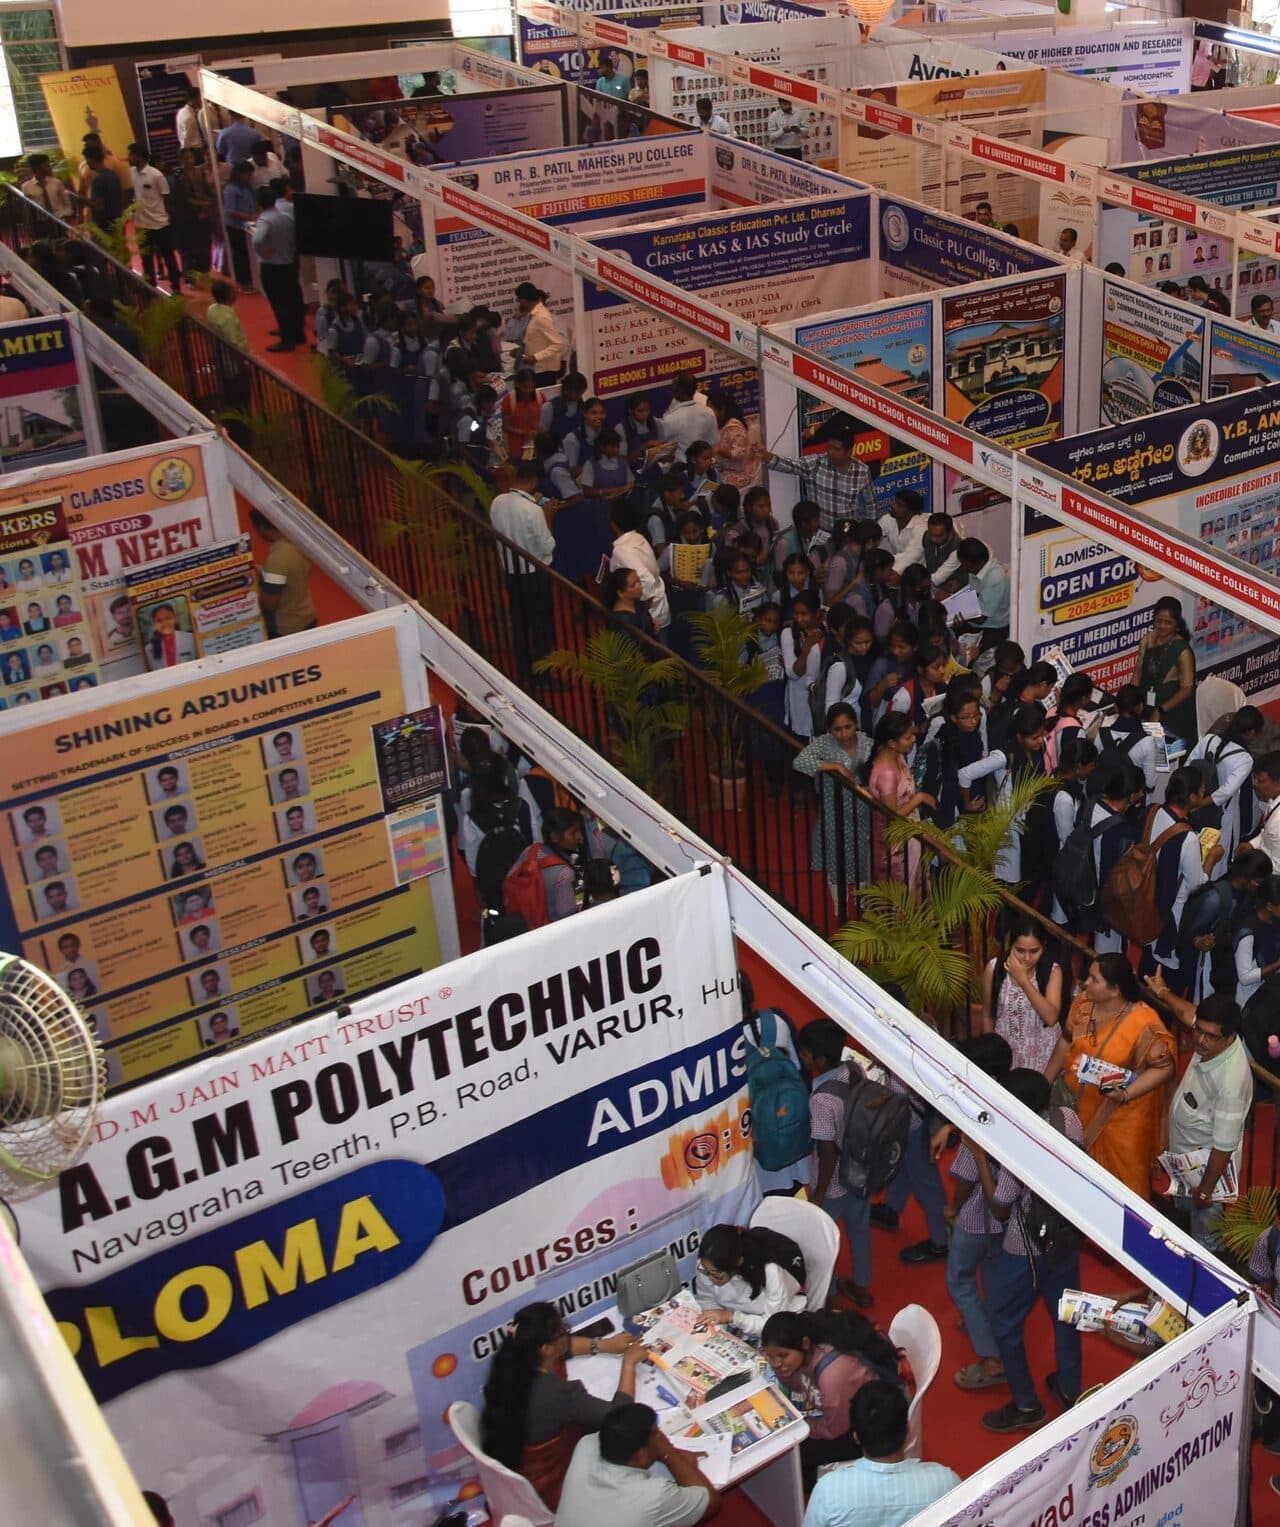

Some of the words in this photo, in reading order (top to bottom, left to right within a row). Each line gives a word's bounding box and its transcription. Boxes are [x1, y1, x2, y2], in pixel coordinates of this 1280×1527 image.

[1028, 51, 1039, 60] OF
[1041, 46, 1072, 58] HIGHER
[1075, 42, 1120, 54] EDUCATION
[1122, 41, 1140, 51] AND
[1142, 37, 1182, 50] RESEARCH
[1123, 72, 1174, 82] HOMOEOPATHIC
[544, 161, 574, 177] PATIL
[577, 154, 626, 172] MAHESH
[628, 152, 643, 166] PU
[646, 144, 694, 162] COLLEGE
[991, 147, 1023, 164] UNIVERSITY
[1023, 156, 1058, 176] DAVANGERE
[542, 200, 586, 216] FUTURE
[589, 193, 630, 208] BEGINS
[653, 230, 696, 246] Karnataka
[698, 224, 728, 239] Classic
[730, 217, 771, 234] Education
[810, 204, 846, 220] Dharwad
[646, 248, 694, 268] Classic
[698, 241, 728, 258] KAS
[774, 227, 810, 246] Study
[814, 219, 854, 238] Circle
[914, 226, 944, 250] Classic
[948, 238, 964, 256] PU
[773, 273, 816, 289] Examinations
[602, 262, 614, 276] THE
[614, 268, 634, 286] CLASSIC
[660, 293, 676, 310] STUDY
[678, 302, 698, 320] CIRCLE
[698, 312, 724, 334] DHARWAD
[734, 296, 754, 307] FDA
[604, 308, 634, 319] Special
[1172, 310, 1195, 327] SCIENCE
[671, 338, 688, 350] SSC
[618, 368, 646, 383] BOOKS
[826, 375, 850, 394] KALUTI
[850, 386, 876, 408] SPORTS
[877, 399, 906, 423] SCHOOL
[907, 412, 950, 446] CHANDARGI
[1222, 418, 1252, 442] Y.B.
[1248, 432, 1260, 446] PU
[882, 453, 928, 474] 2024-2025
[1223, 444, 1266, 465] Commerce
[70, 478, 145, 510] CLASSES
[1195, 482, 1240, 509] INCREDIBLE
[1241, 472, 1272, 492] RESULTS
[117, 515, 203, 568] NEET
[1082, 504, 1118, 532] ANNIGERI
[1131, 529, 1164, 554] SCIENCE
[1174, 550, 1222, 582] COMMERCE
[1222, 574, 1260, 601] COLLEGE
[1043, 570, 1094, 602] OPEN
[1100, 560, 1136, 585] FOR
[1068, 588, 1130, 618] 2024-2025
[55, 707, 173, 754] SHINING
[179, 664, 323, 720] ARJUNITES
[12, 772, 58, 792] SETTING
[60, 750, 128, 780] TRADEMARK
[143, 732, 191, 756] SUCCESS
[251, 696, 314, 723] COMPETITIVE
[168, 734, 236, 761] ENGINEERING
[204, 858, 249, 880] MEDICAL
[169, 1071, 240, 1115] JAIN
[248, 1034, 330, 1082] MATT
[336, 996, 432, 1046] TRUST
[59, 1100, 261, 1234] A.G.M
[270, 937, 663, 1146] POLYTECHNIC
[72, 1179, 265, 1273] Navagraha
[271, 1132, 380, 1186] Teerth,
[456, 1056, 540, 1109] Road,
[545, 993, 685, 1065] VARUR,
[462, 1216, 617, 1306] Courses
[1114, 1412, 1234, 1522] ADMINISTRATION
